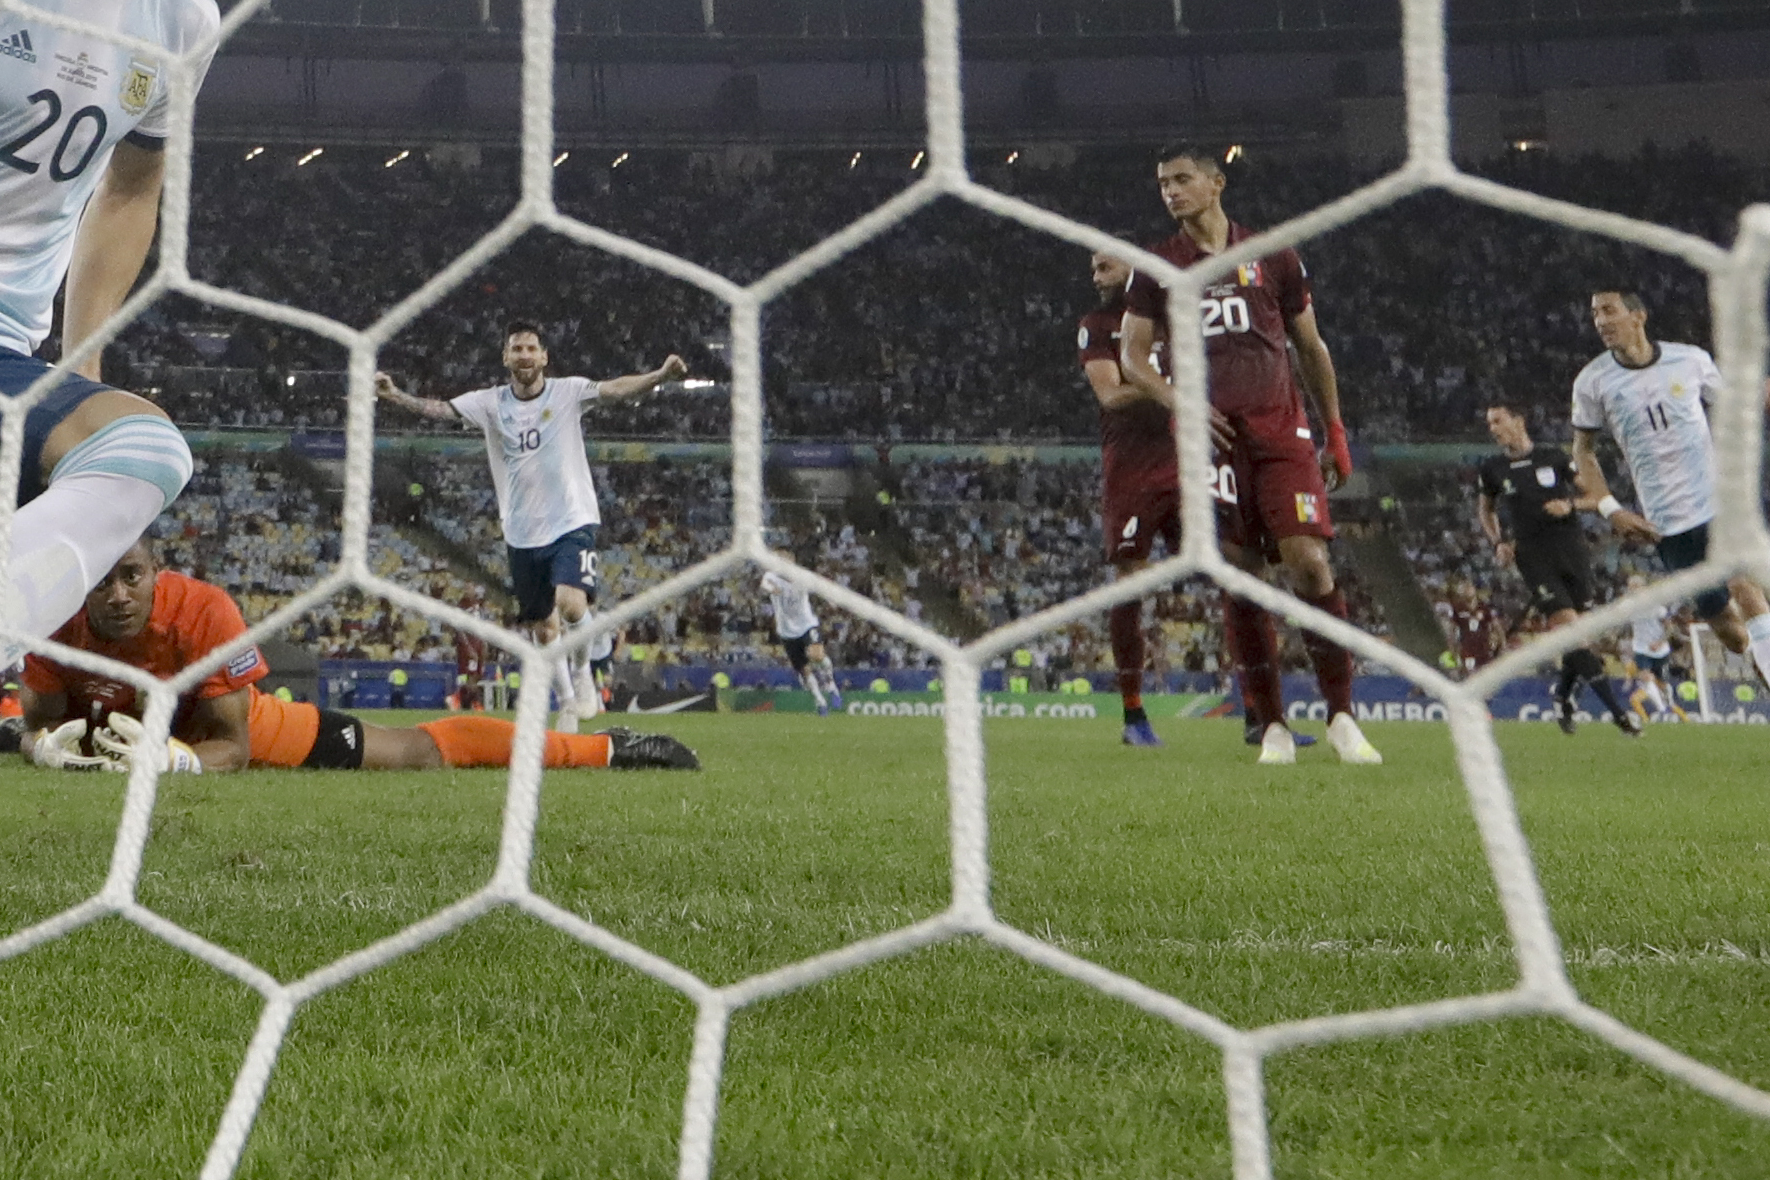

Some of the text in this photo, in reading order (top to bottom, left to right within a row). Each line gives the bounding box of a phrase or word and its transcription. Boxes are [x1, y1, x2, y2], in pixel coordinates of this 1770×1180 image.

[1200, 297, 1250, 337] 20
[1645, 402, 1668, 431] 11
[518, 428, 541, 452] 10
[579, 550, 598, 577] 10
[847, 695, 1097, 719] copaamicacom
[1287, 701, 1449, 722] COMEBO
